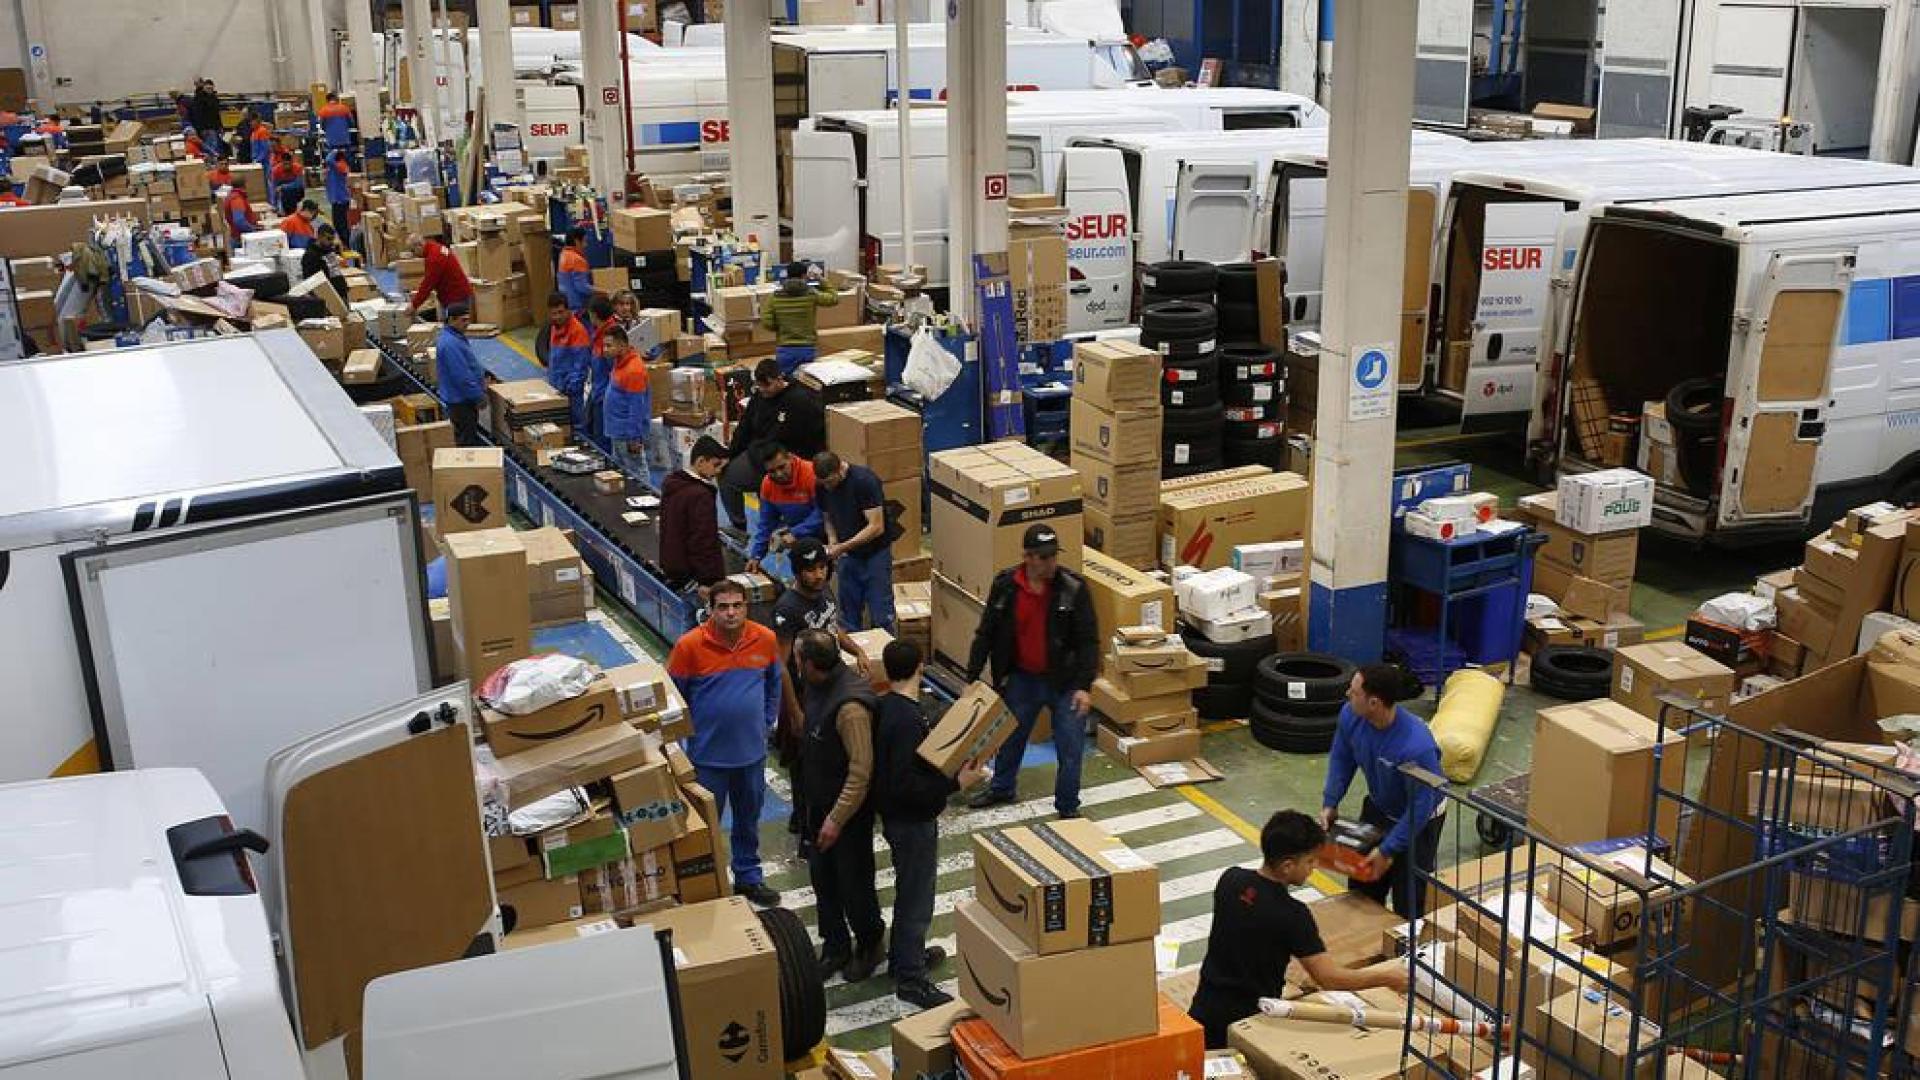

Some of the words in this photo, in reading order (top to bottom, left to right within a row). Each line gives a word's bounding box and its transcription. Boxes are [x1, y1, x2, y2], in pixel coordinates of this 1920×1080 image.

[530, 123, 570, 136] SEUR
[1067, 214, 1127, 240] SEUR
[1067, 246, 1126, 260] seur.com
[1483, 247, 1542, 270] SEUR
